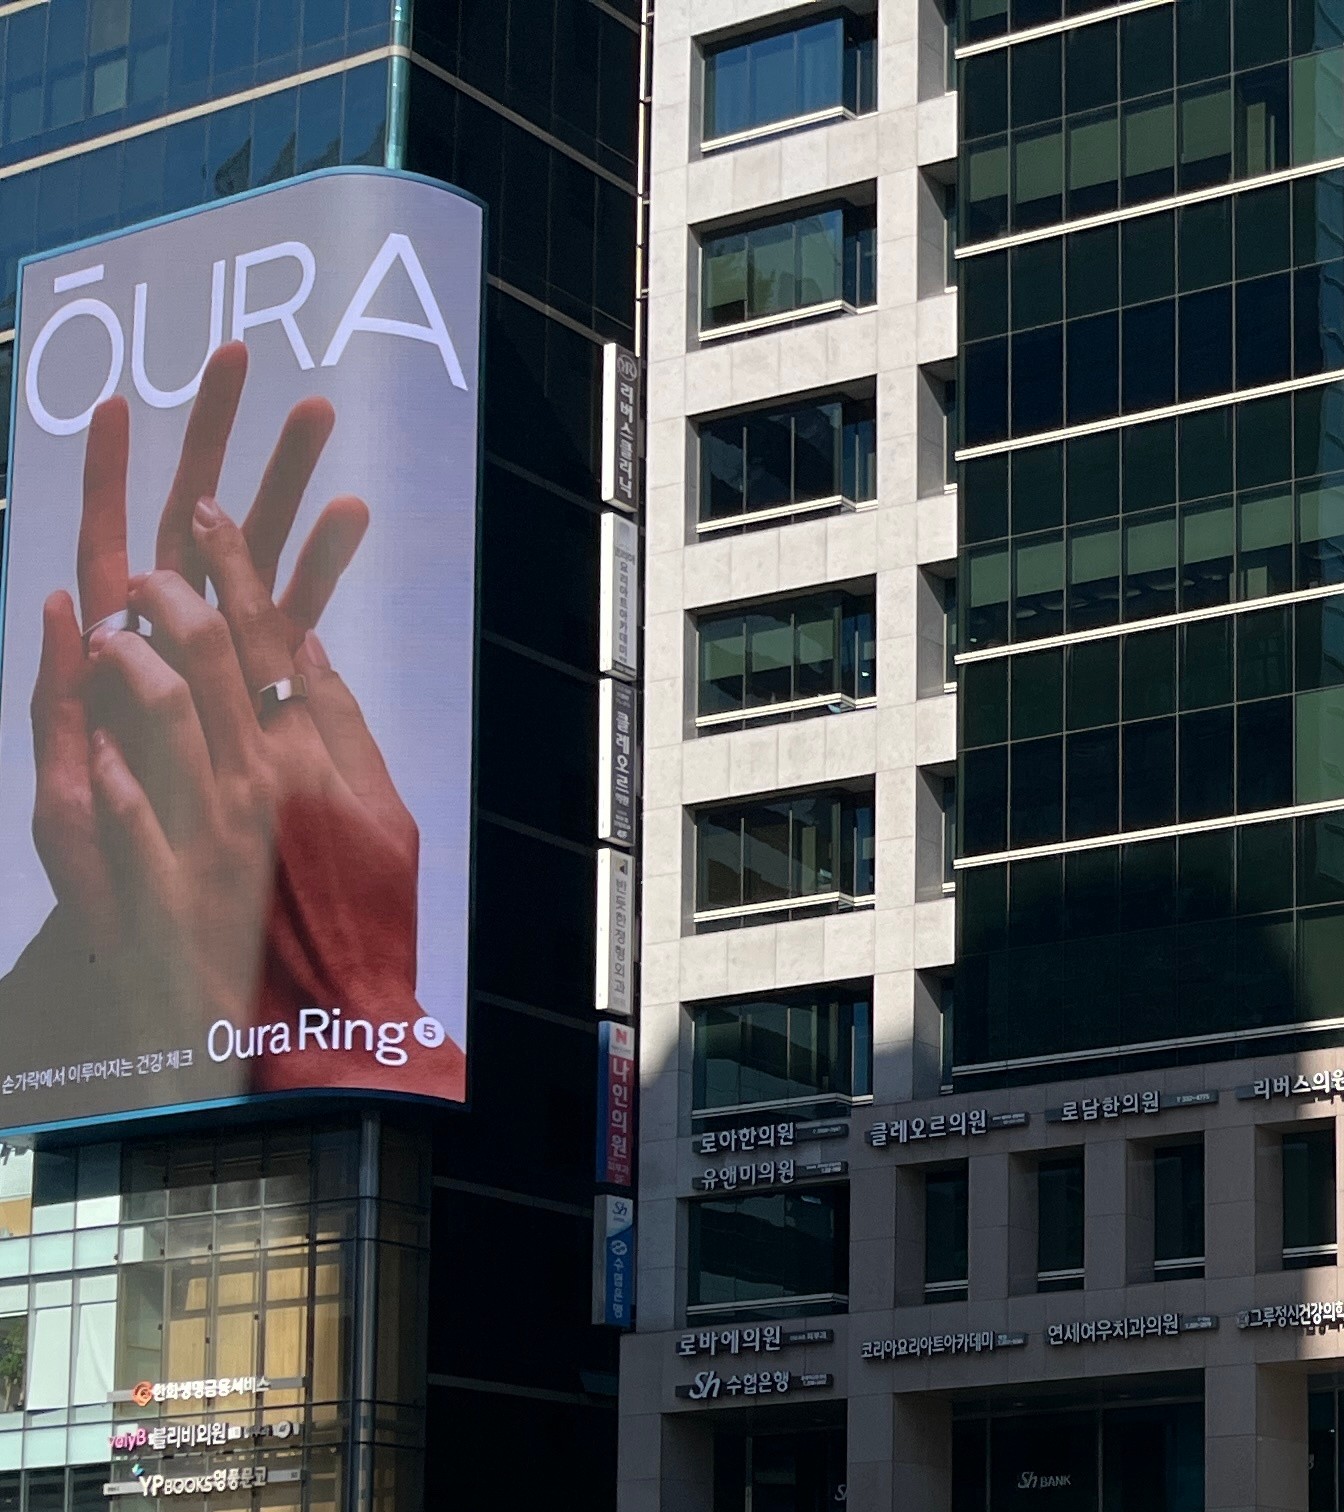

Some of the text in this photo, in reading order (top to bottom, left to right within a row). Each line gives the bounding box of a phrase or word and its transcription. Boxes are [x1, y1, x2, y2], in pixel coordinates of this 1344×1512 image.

[207, 1008, 437, 1067] Oura Ring 5
[2, 1048, 193, 1095] 손가락에서 이루어지는 건강 체크
[611, 1059, 630, 1159] 나인의원
[1060, 1090, 1160, 1122] 로담한의원
[700, 1121, 795, 1154] 로아한의원
[870, 1109, 987, 1148] 클레오르의원
[701, 1159, 795, 1191] 유앤미의원
[678, 1325, 782, 1356] 로바에의원
[860, 1331, 995, 1360] 코리아요리아트아카데미
[1047, 1313, 1180, 1346] 연세여우치과의원
[688, 1371, 720, 1400] Sh
[726, 1370, 790, 1396] 수협은행
[152, 1422, 226, 1450] 블리비의원
[213, 1465, 268, 1492] 영풍문고
[1017, 1471, 1072, 1489] Sh BANK
